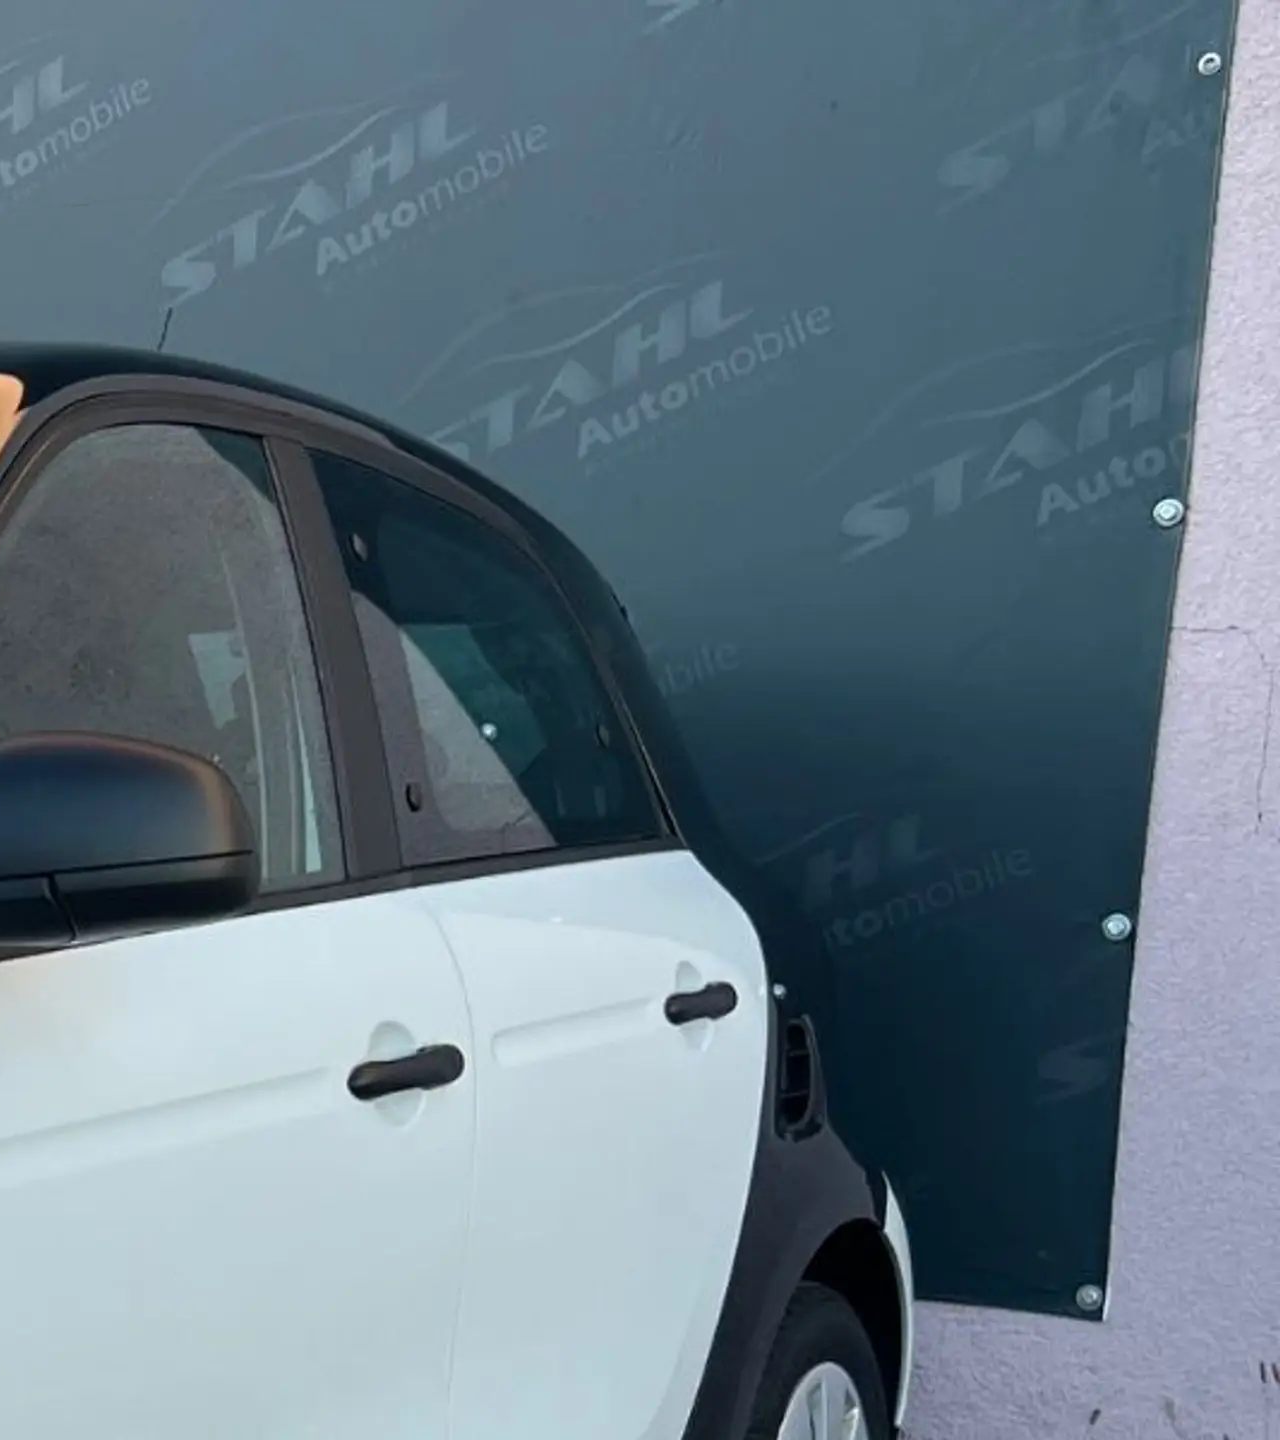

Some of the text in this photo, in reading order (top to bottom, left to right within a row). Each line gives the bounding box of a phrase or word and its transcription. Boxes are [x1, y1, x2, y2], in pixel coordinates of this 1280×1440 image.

[160, 101, 476, 306] STAHL
[316, 119, 550, 277] Automobile
[577, 303, 833, 460] Automobile
